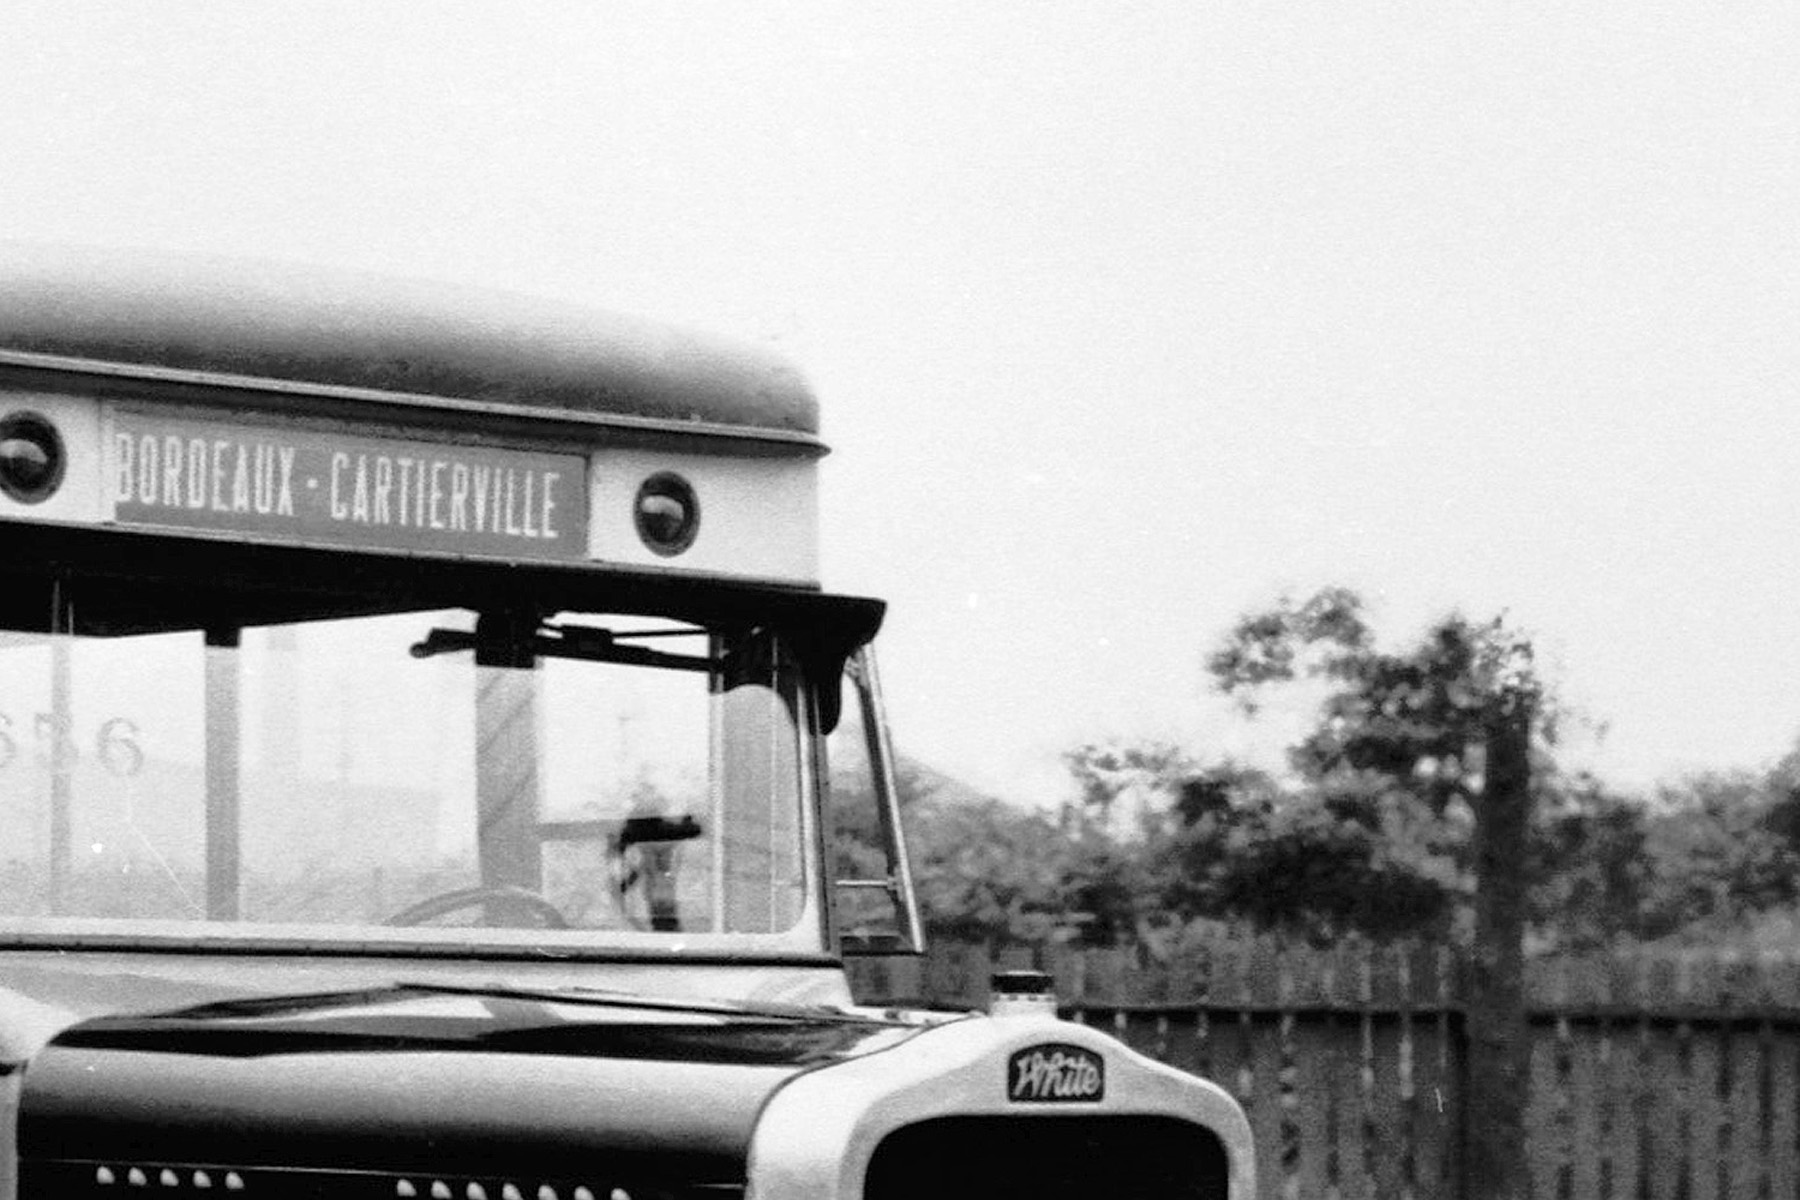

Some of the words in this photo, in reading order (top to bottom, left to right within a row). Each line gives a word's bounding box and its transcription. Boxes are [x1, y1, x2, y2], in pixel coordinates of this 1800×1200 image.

[114, 433, 296, 516] BORDEAUX
[330, 452, 560, 538] CARTIERVILLE
[1014, 1051, 1100, 1097] White
